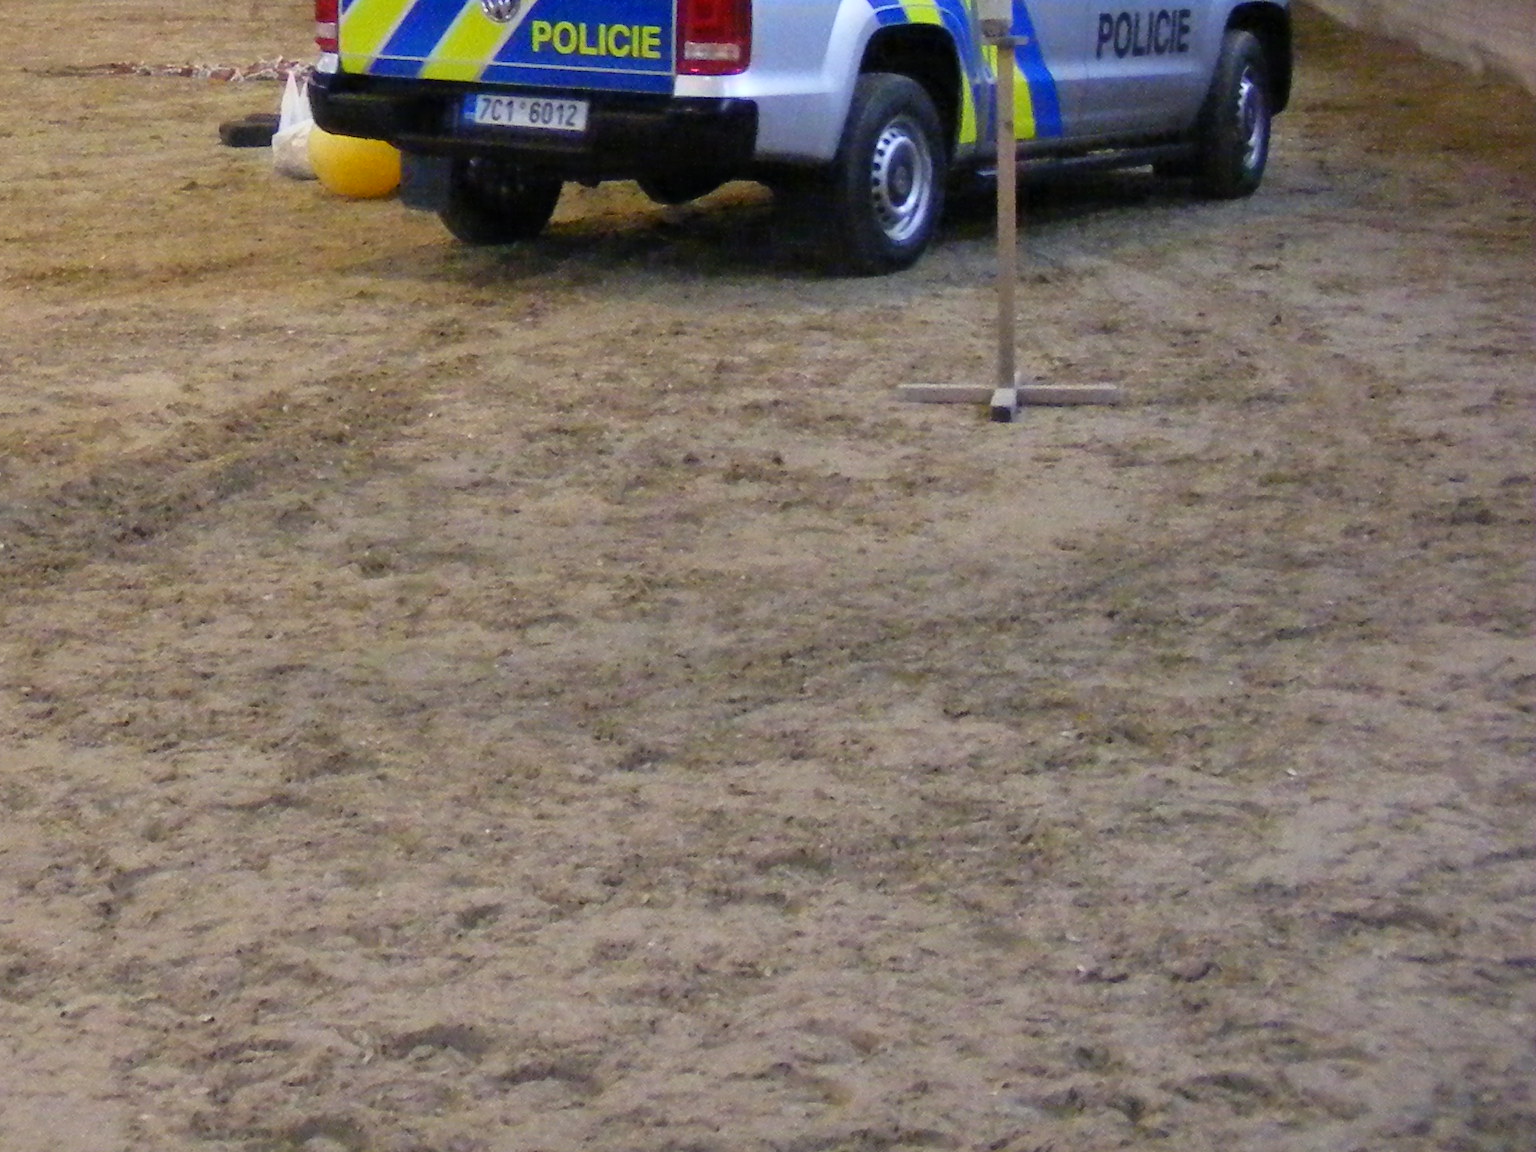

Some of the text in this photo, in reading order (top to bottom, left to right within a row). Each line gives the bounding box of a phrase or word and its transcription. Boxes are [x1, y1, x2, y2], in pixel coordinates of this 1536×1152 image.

[531, 19, 662, 59] POLICIE
[1095, 9, 1192, 61] POLICIE
[478, 97, 578, 126] 7C1 6012
